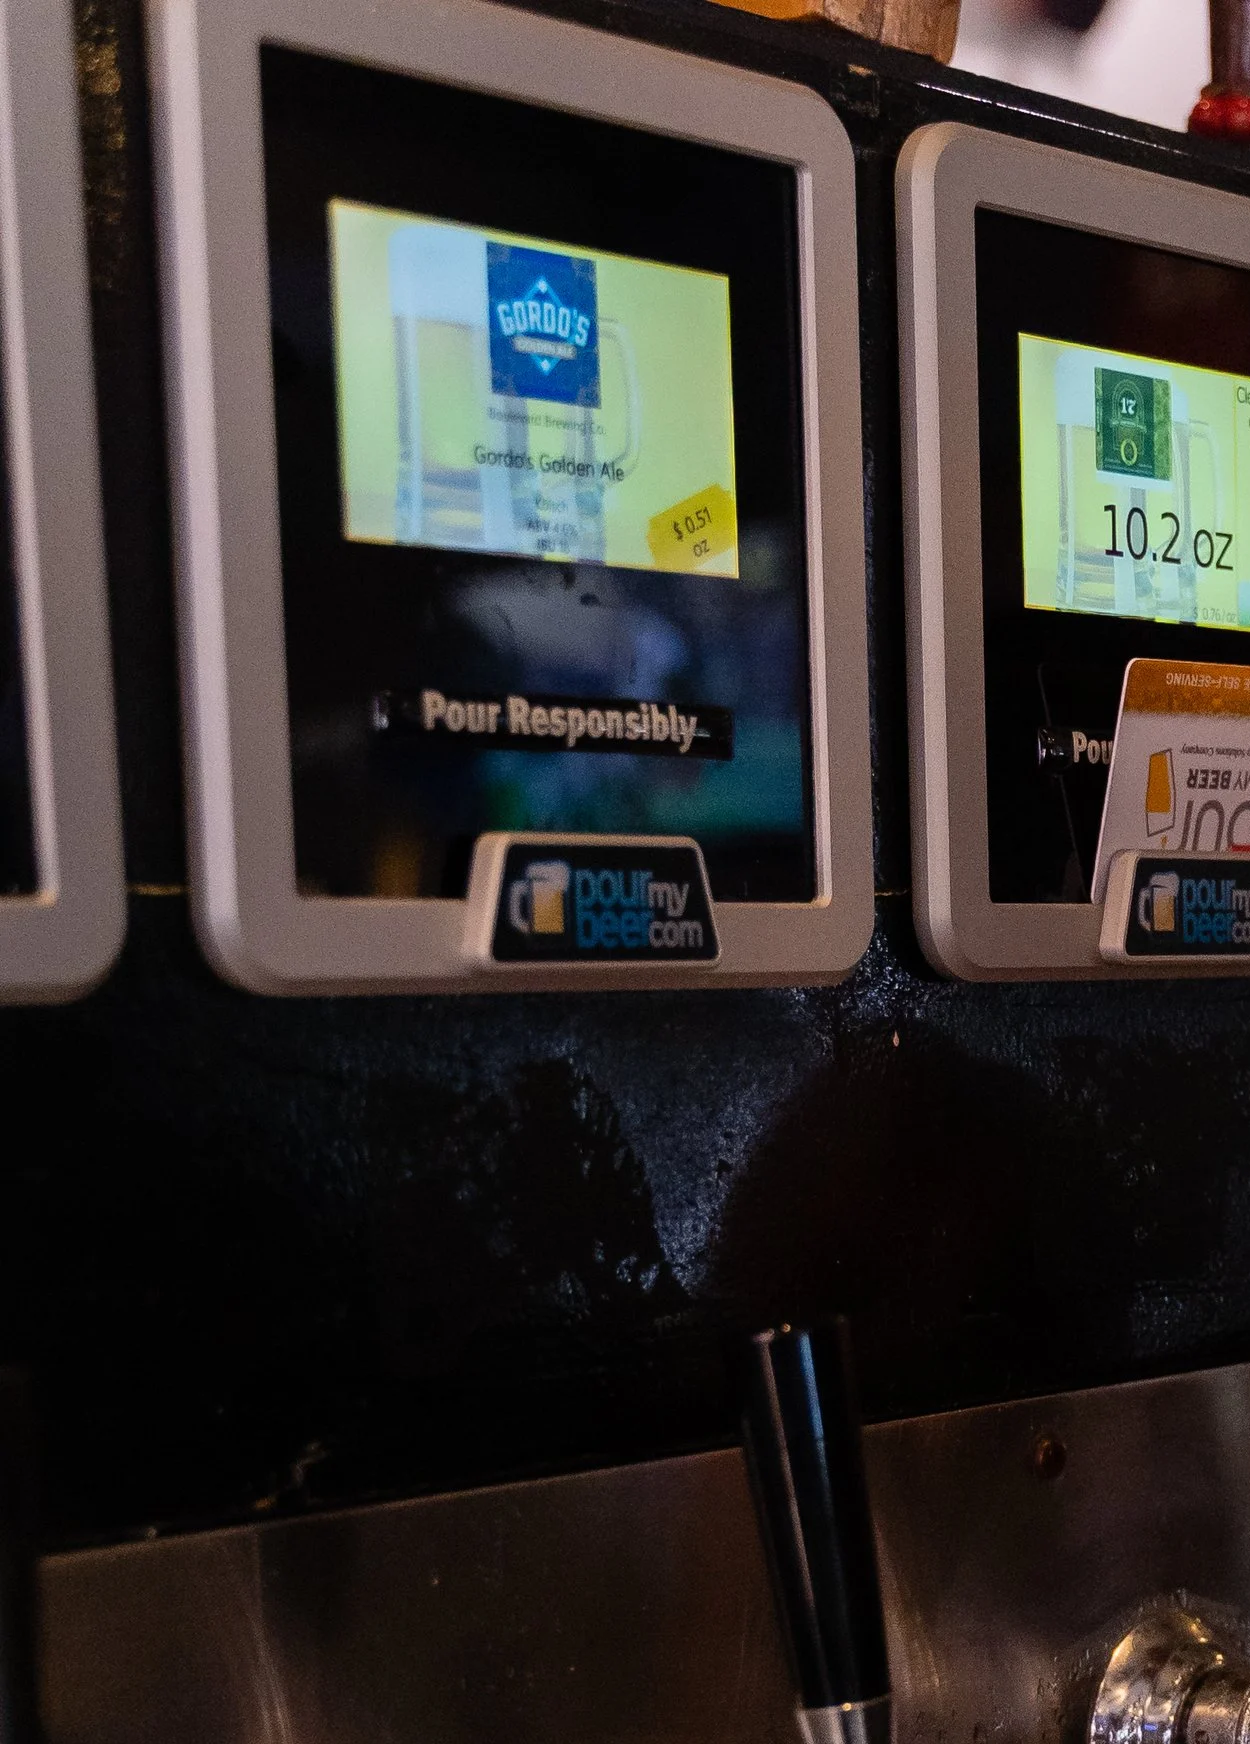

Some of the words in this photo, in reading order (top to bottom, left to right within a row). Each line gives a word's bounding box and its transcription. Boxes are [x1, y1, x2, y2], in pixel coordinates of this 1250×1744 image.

[497, 300, 591, 347] GORDO'S
[474, 444, 534, 470] Gordo's
[539, 453, 595, 478] Golden
[601, 462, 625, 482] Ale
[684, 506, 712, 534] 0.51
[1103, 504, 1181, 565] 10.2
[693, 538, 710, 557] oz
[1166, 672, 1242, 691] SELF-SERVING
[420, 688, 500, 734] Pour
[506, 694, 698, 754] Responsibly
[1071, 731, 1114, 765] Pou
[1182, 743, 1214, 757] Company
[1186, 768, 1232, 790] BEER
